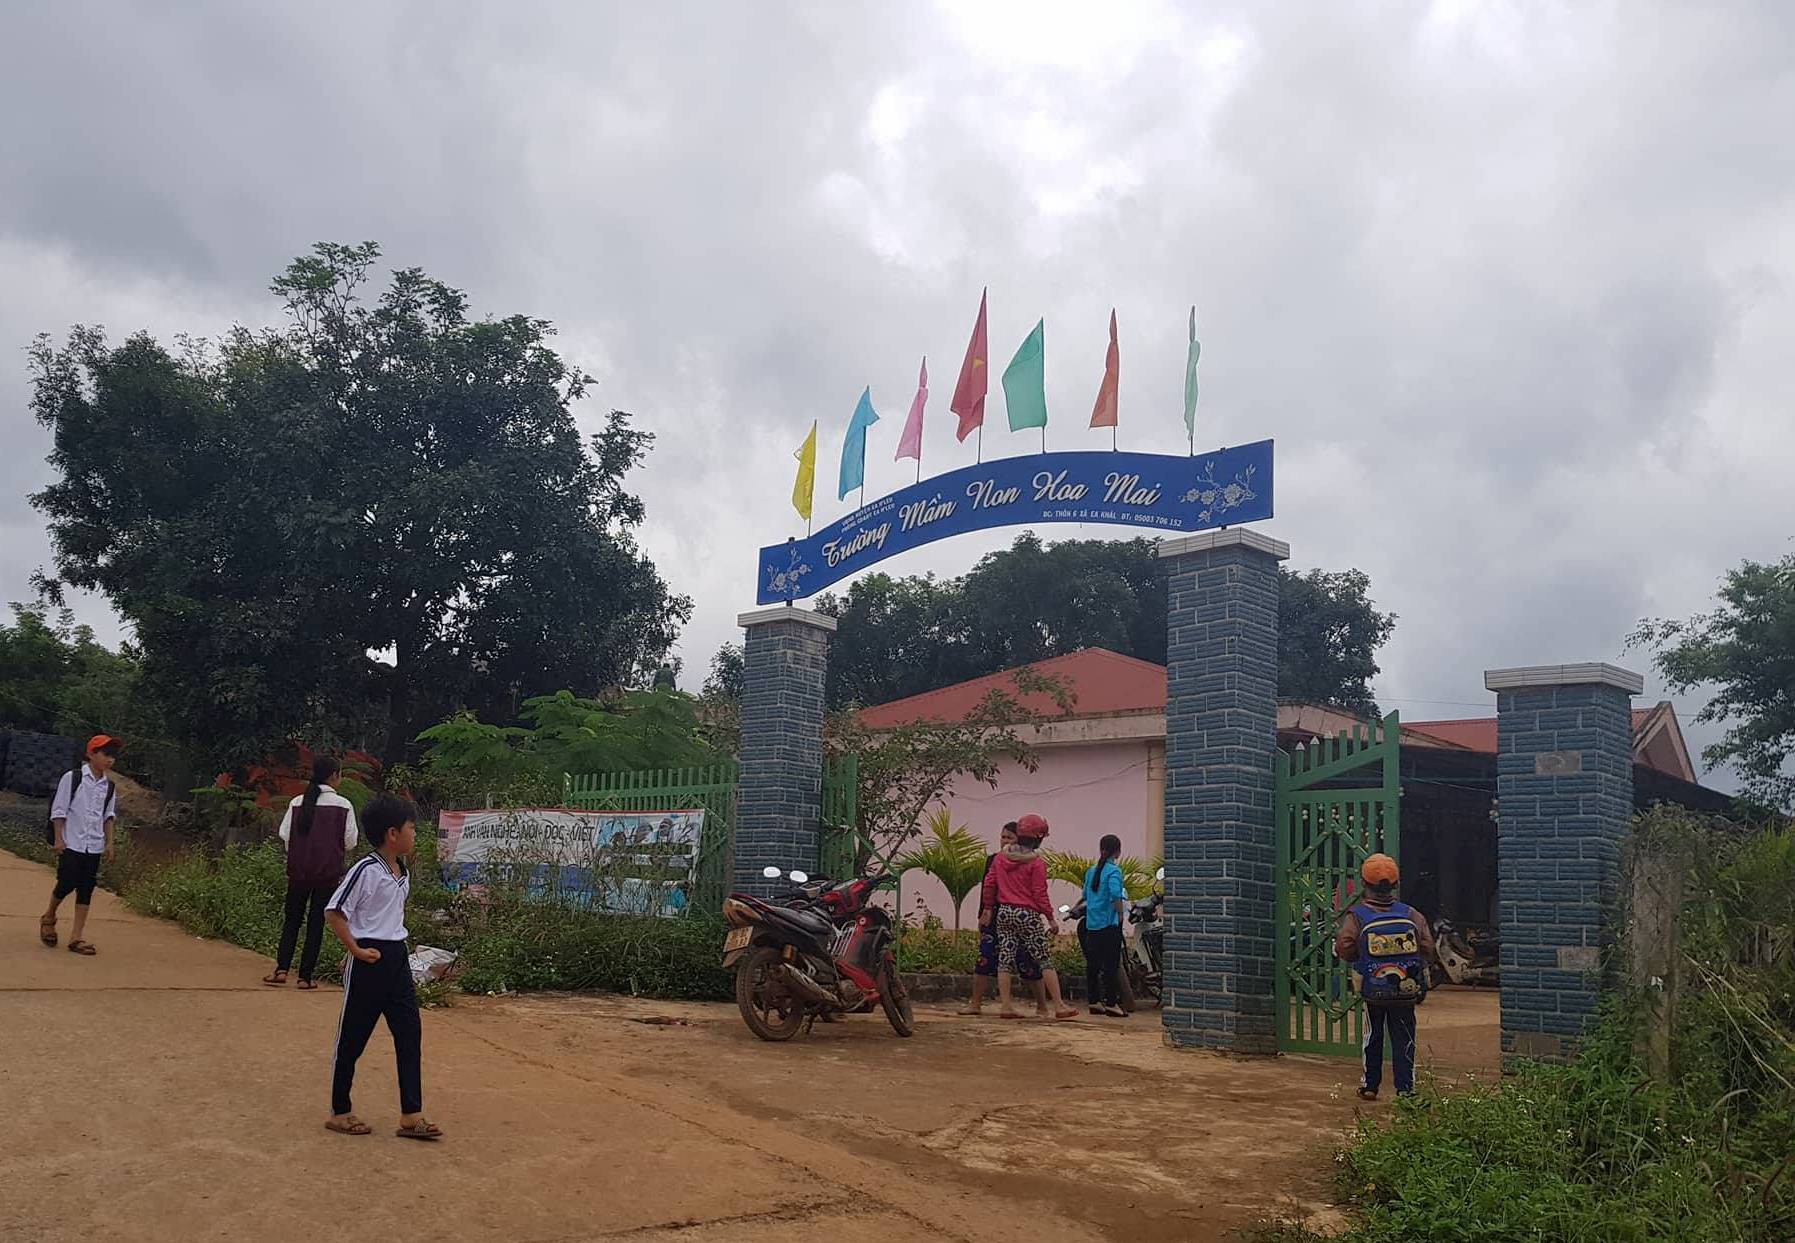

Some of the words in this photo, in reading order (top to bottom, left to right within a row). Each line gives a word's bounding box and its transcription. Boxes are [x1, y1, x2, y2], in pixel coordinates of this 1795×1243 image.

[821, 522, 892, 568] Trường
[899, 492, 957, 532] Mầm
[966, 478, 1021, 510] Non
[1032, 469, 1089, 502] Hoa
[1104, 472, 1162, 507] Mai
[1055, 508, 1071, 518] THÔN
